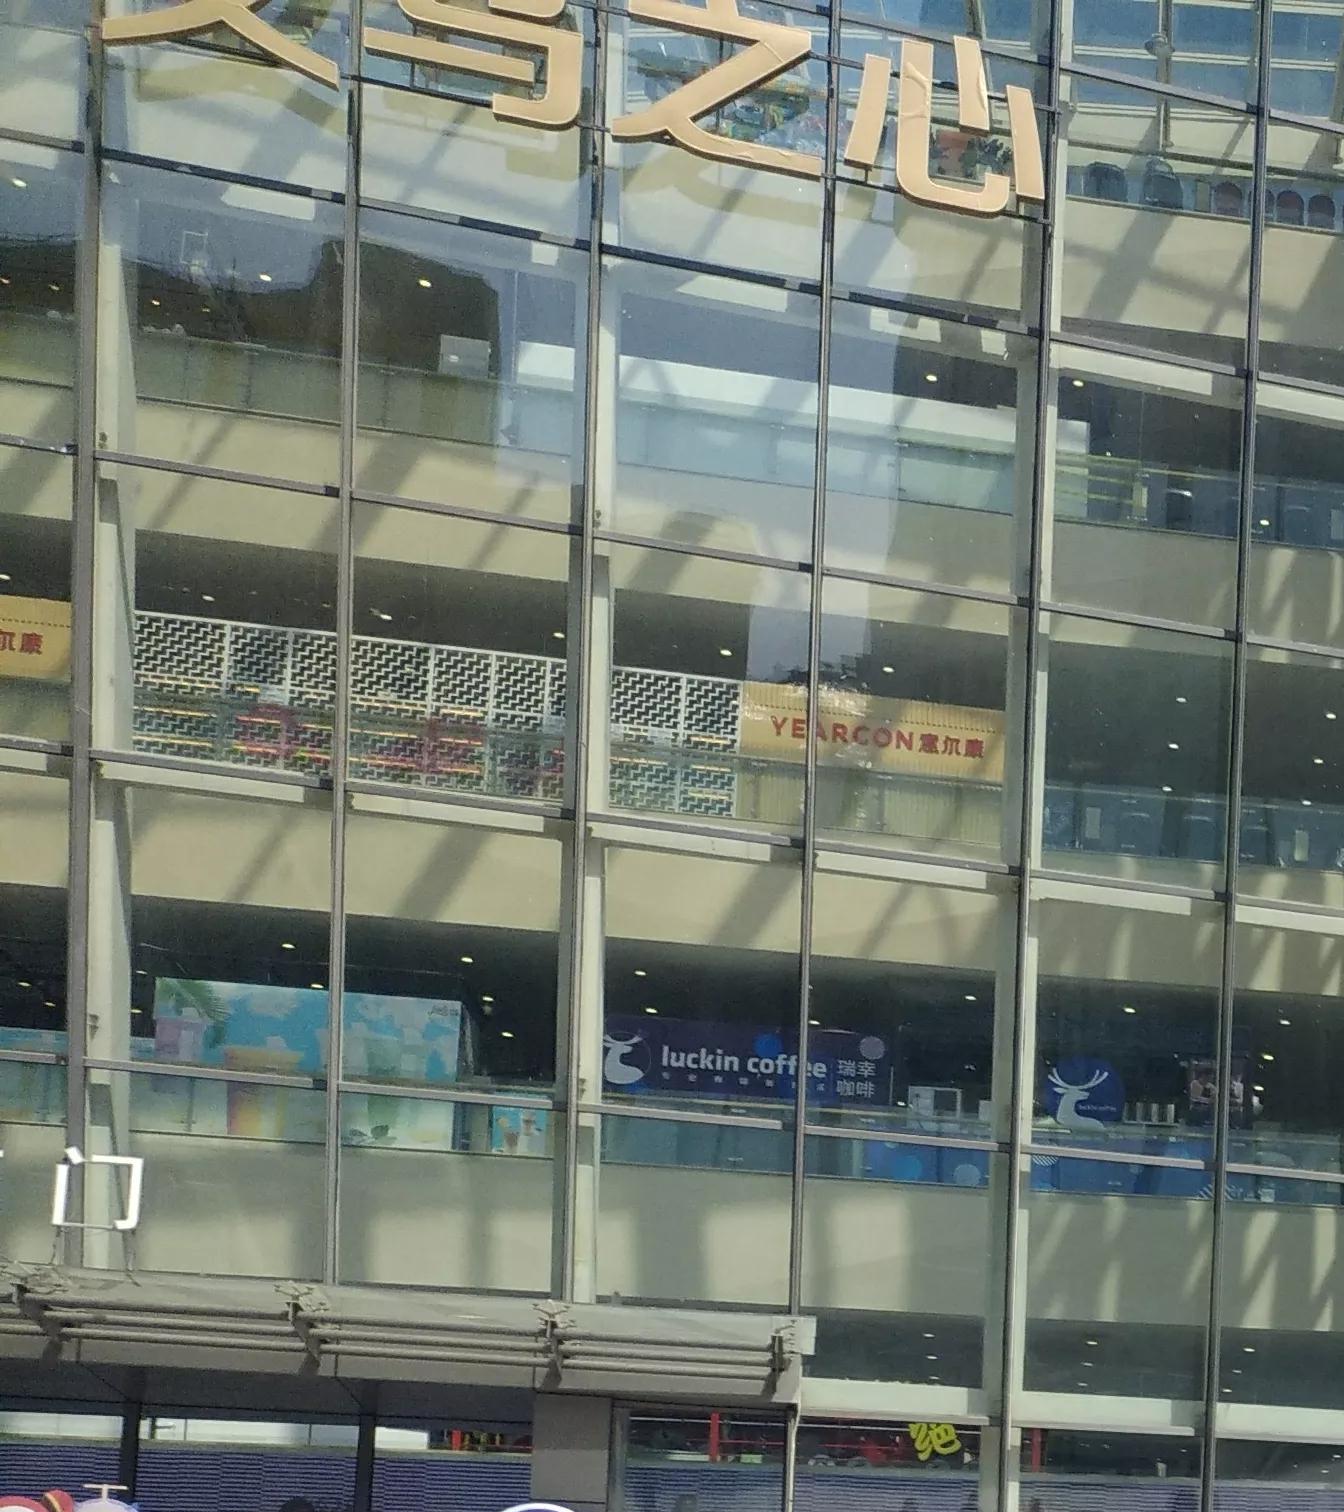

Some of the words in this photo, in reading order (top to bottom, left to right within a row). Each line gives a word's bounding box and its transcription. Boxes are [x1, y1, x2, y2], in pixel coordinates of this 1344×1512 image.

[770, 714, 914, 752] YEARCON
[661, 1044, 739, 1073] luckin
[836, 1058, 877, 1079] 瑞幸
[836, 1078, 876, 1099] 咖啡
